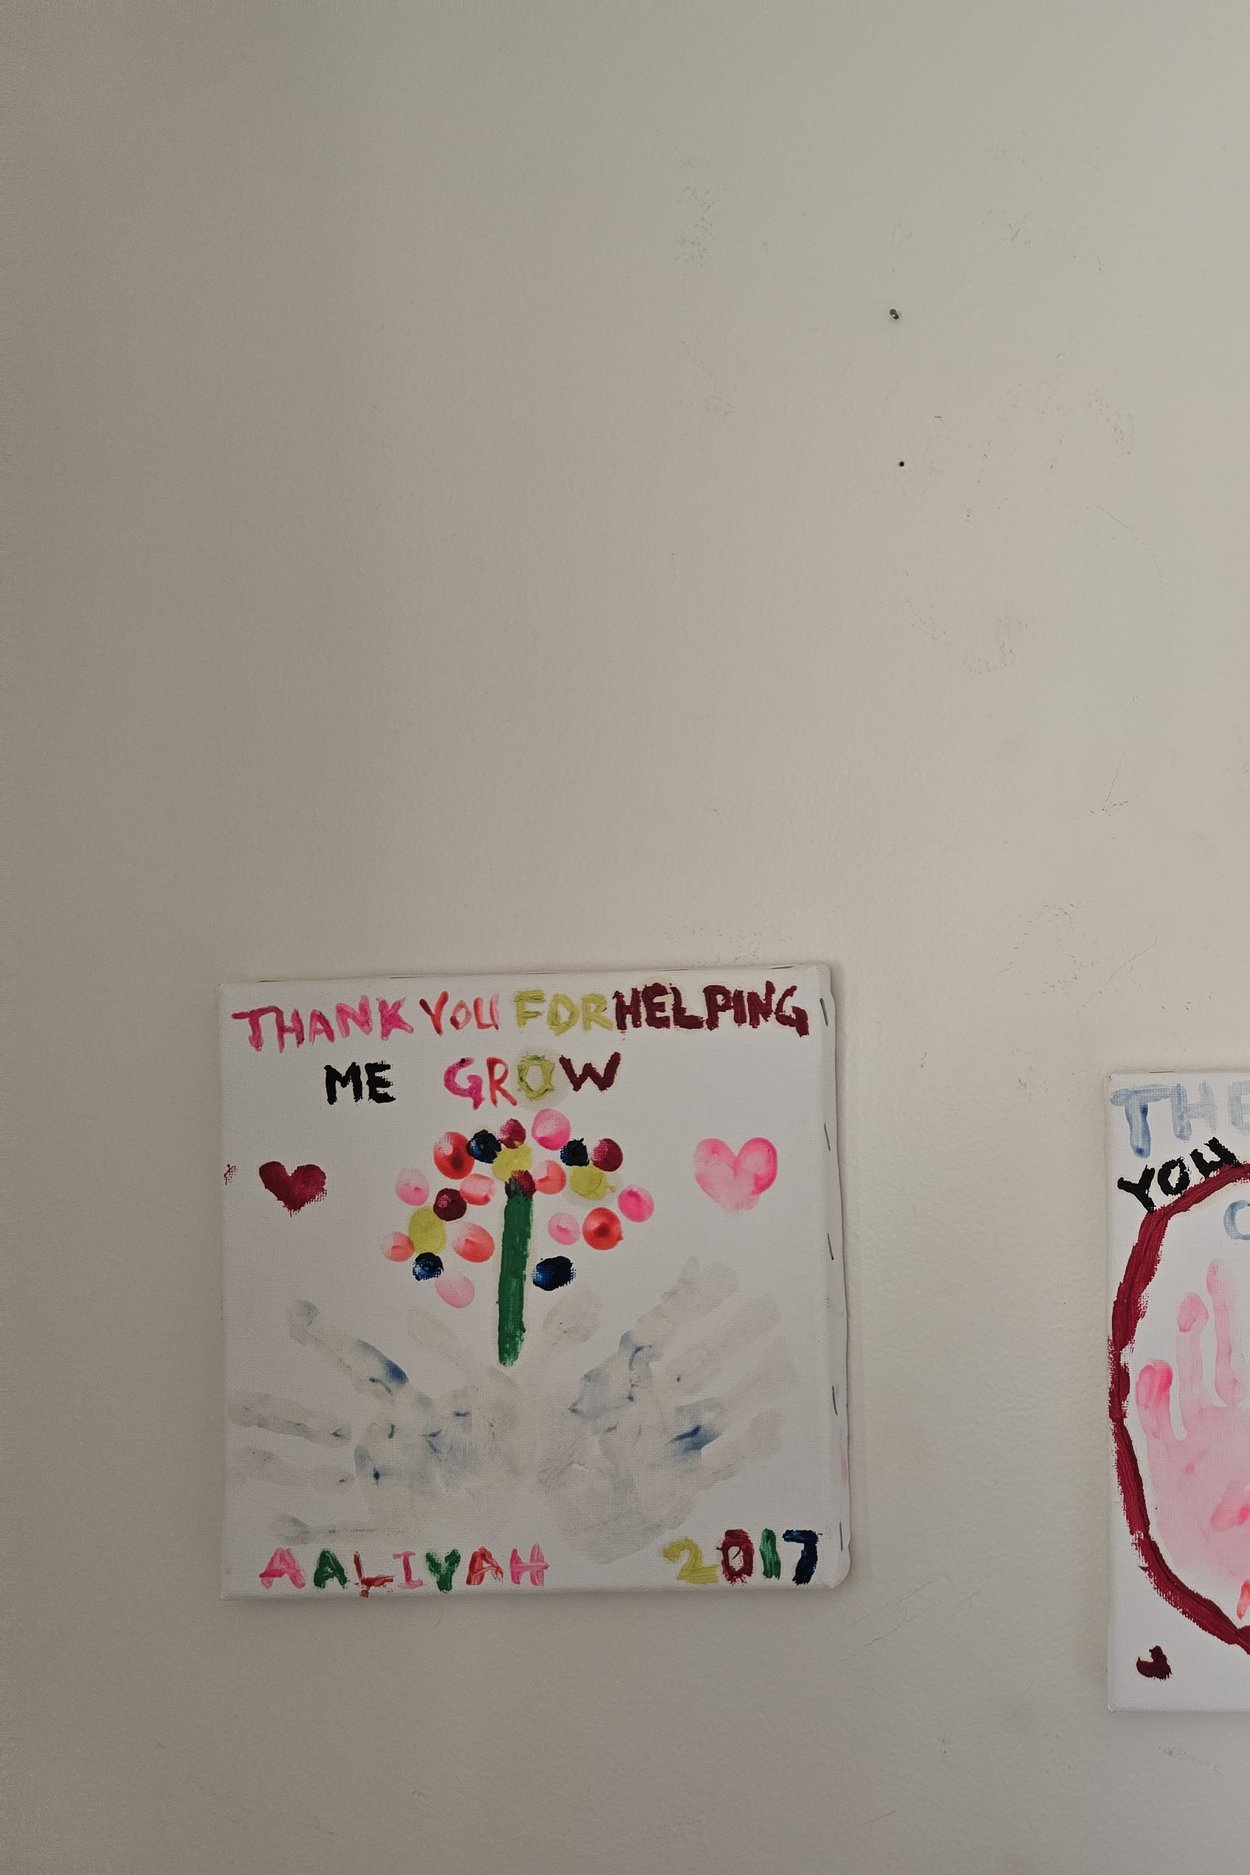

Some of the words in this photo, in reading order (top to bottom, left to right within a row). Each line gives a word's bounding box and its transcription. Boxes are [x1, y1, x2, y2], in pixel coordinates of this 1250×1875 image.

[232, 995, 414, 1053] THANK
[420, 991, 499, 1036] YOU
[514, 989, 614, 1034] FOR
[614, 981, 810, 1037] HELPING
[324, 1062, 397, 1105] ME
[443, 1052, 622, 1109] GROW
[1117, 1137, 1244, 1213] YOU
[259, 1544, 550, 1598] AALIYAH
[662, 1528, 823, 1586] 2017
